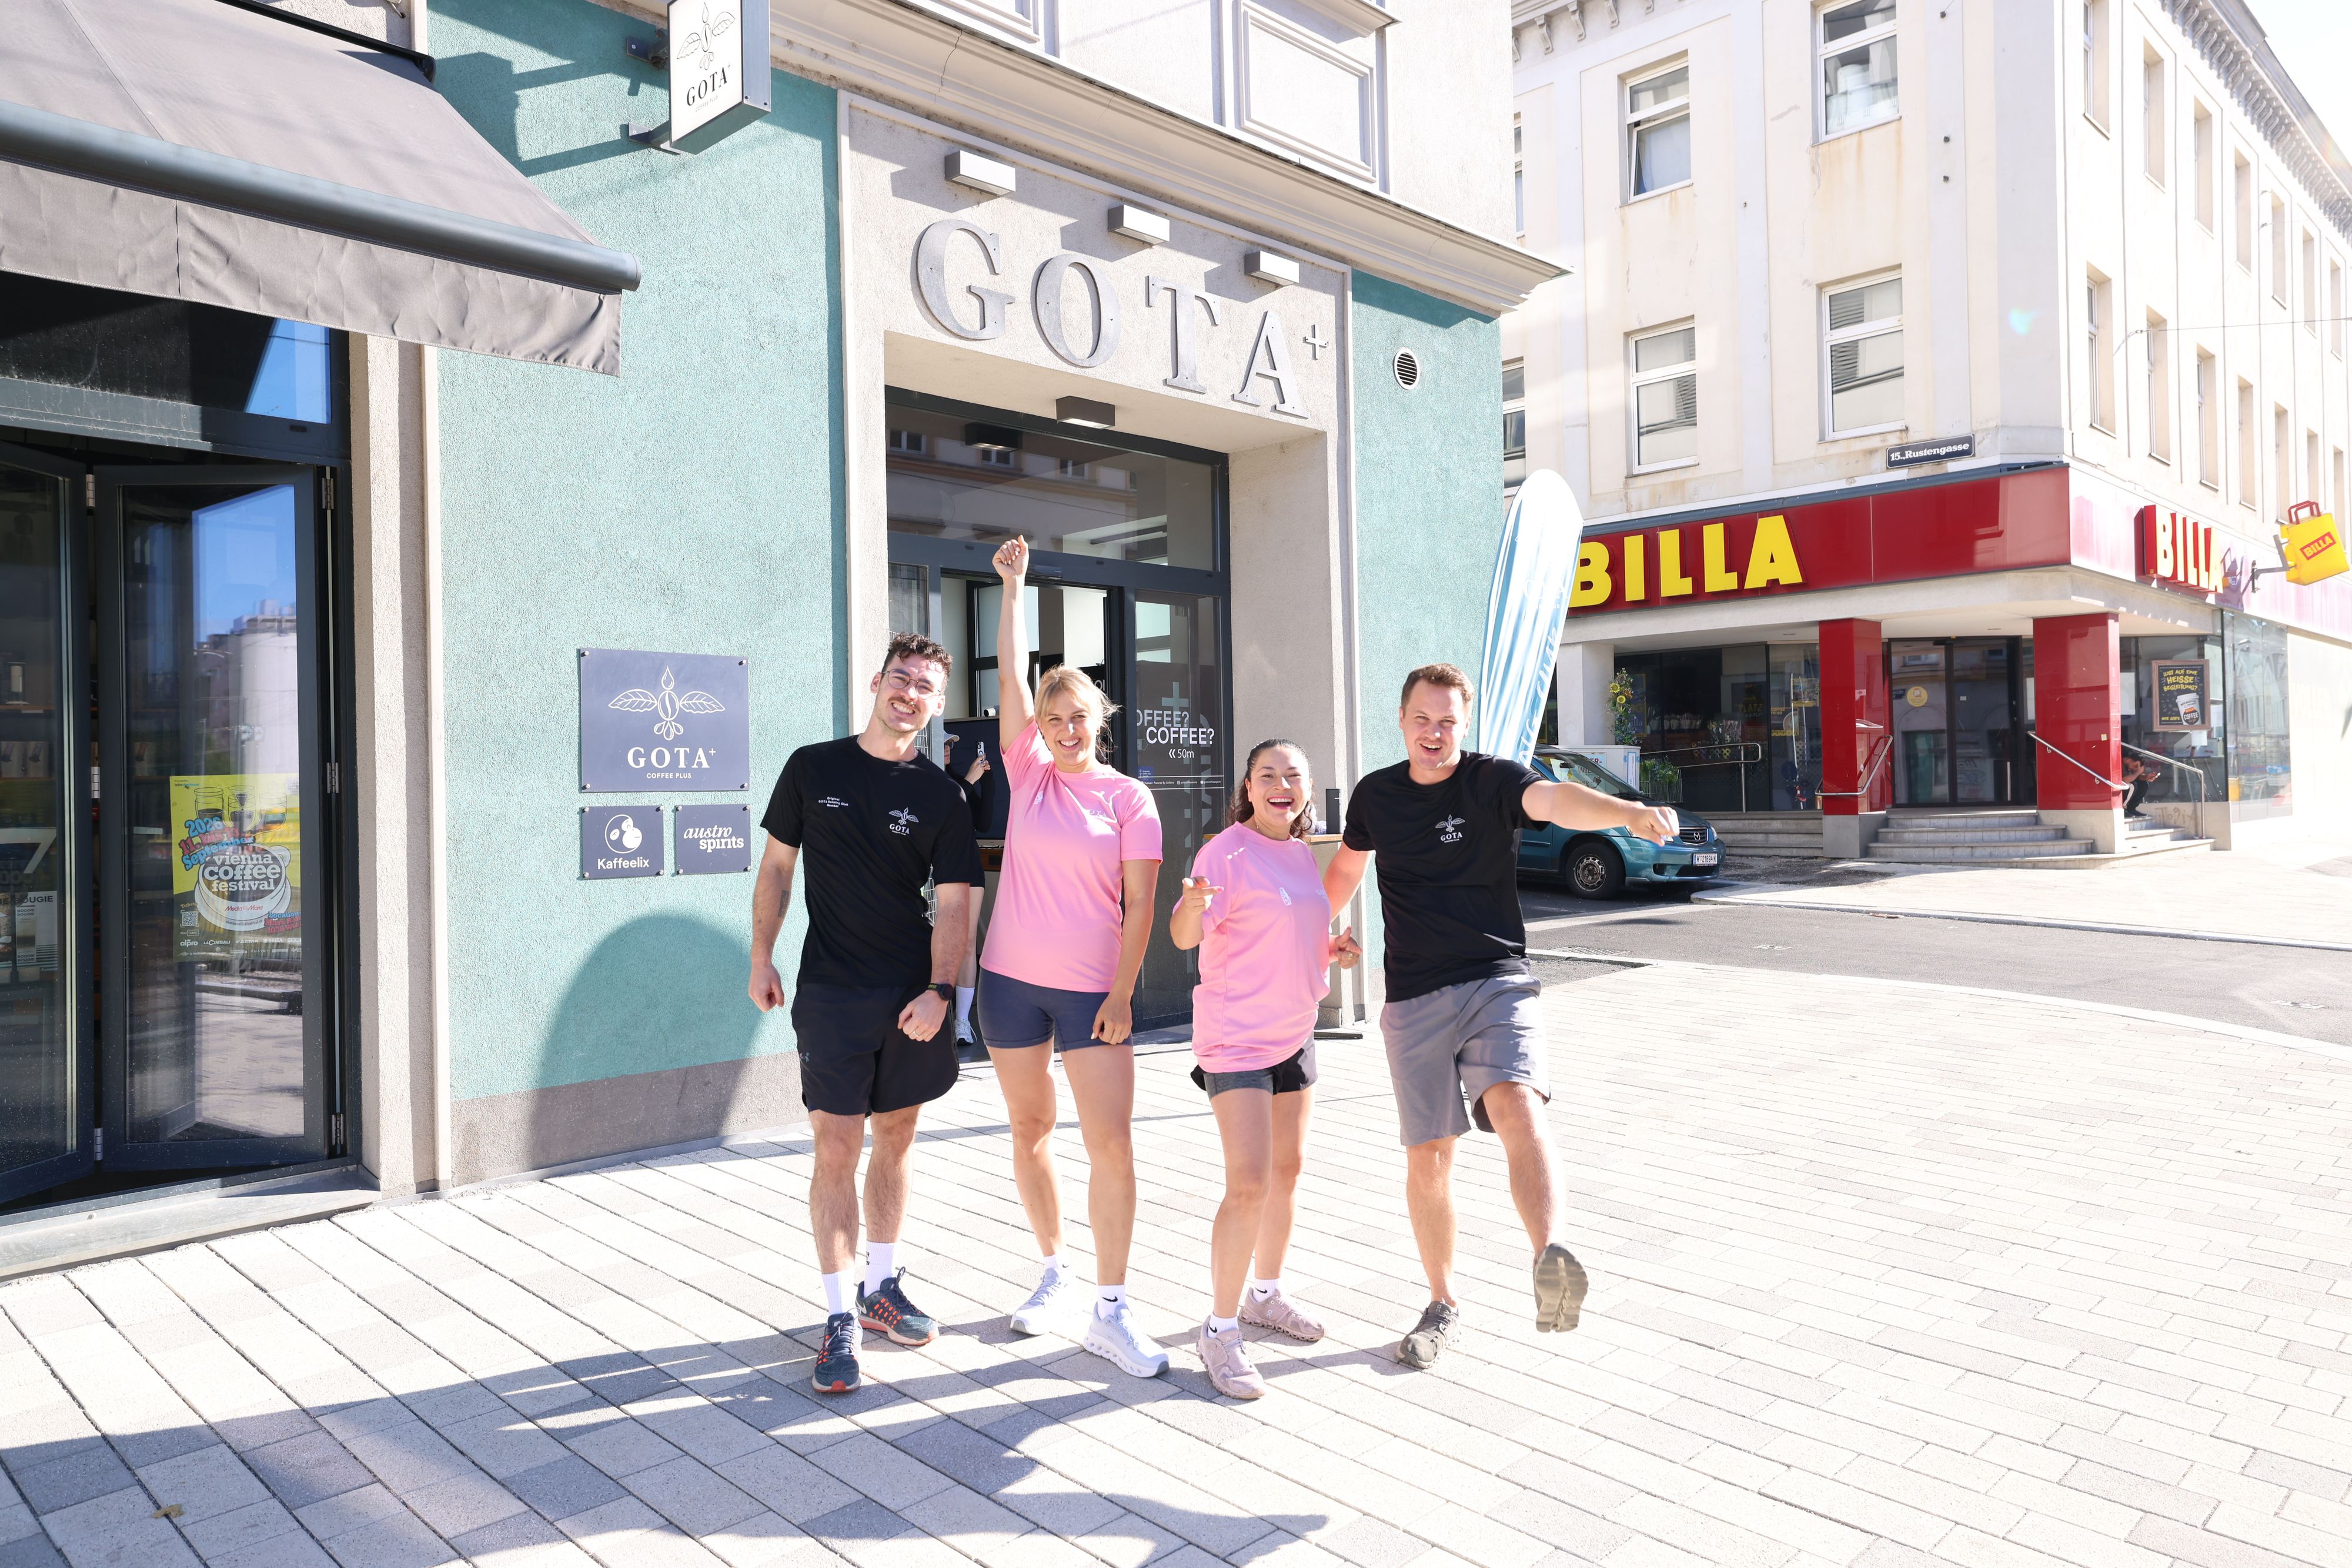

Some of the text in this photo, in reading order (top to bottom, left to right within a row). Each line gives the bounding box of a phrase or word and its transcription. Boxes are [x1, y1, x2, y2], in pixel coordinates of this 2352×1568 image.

[695, 94, 719, 112] COFFEE PLUS
[2152, 504, 2224, 594] BILLA
[2303, 533, 2335, 557] BILLA
[1569, 515, 1804, 607] BILLA
[2166, 676, 2194, 684] HEISSE
[1137, 709, 1190, 727] OFFEE?
[1146, 727, 1215, 745] COFFEE?
[1089, 808, 1107, 818] OTA
[683, 824, 733, 840] austro
[889, 823, 910, 834] GOTA
[1440, 831, 1463, 841] GOTA
[699, 835, 744, 853] spirits
[182, 836, 254, 870] September
[214, 852, 273, 865] vienna
[597, 855, 650, 870] Kaffeelix
[203, 864, 281, 881] coffee
[212, 879, 275, 892] festival
[15, 895, 54, 905] OUGIE
[180, 939, 198, 947] alpro
